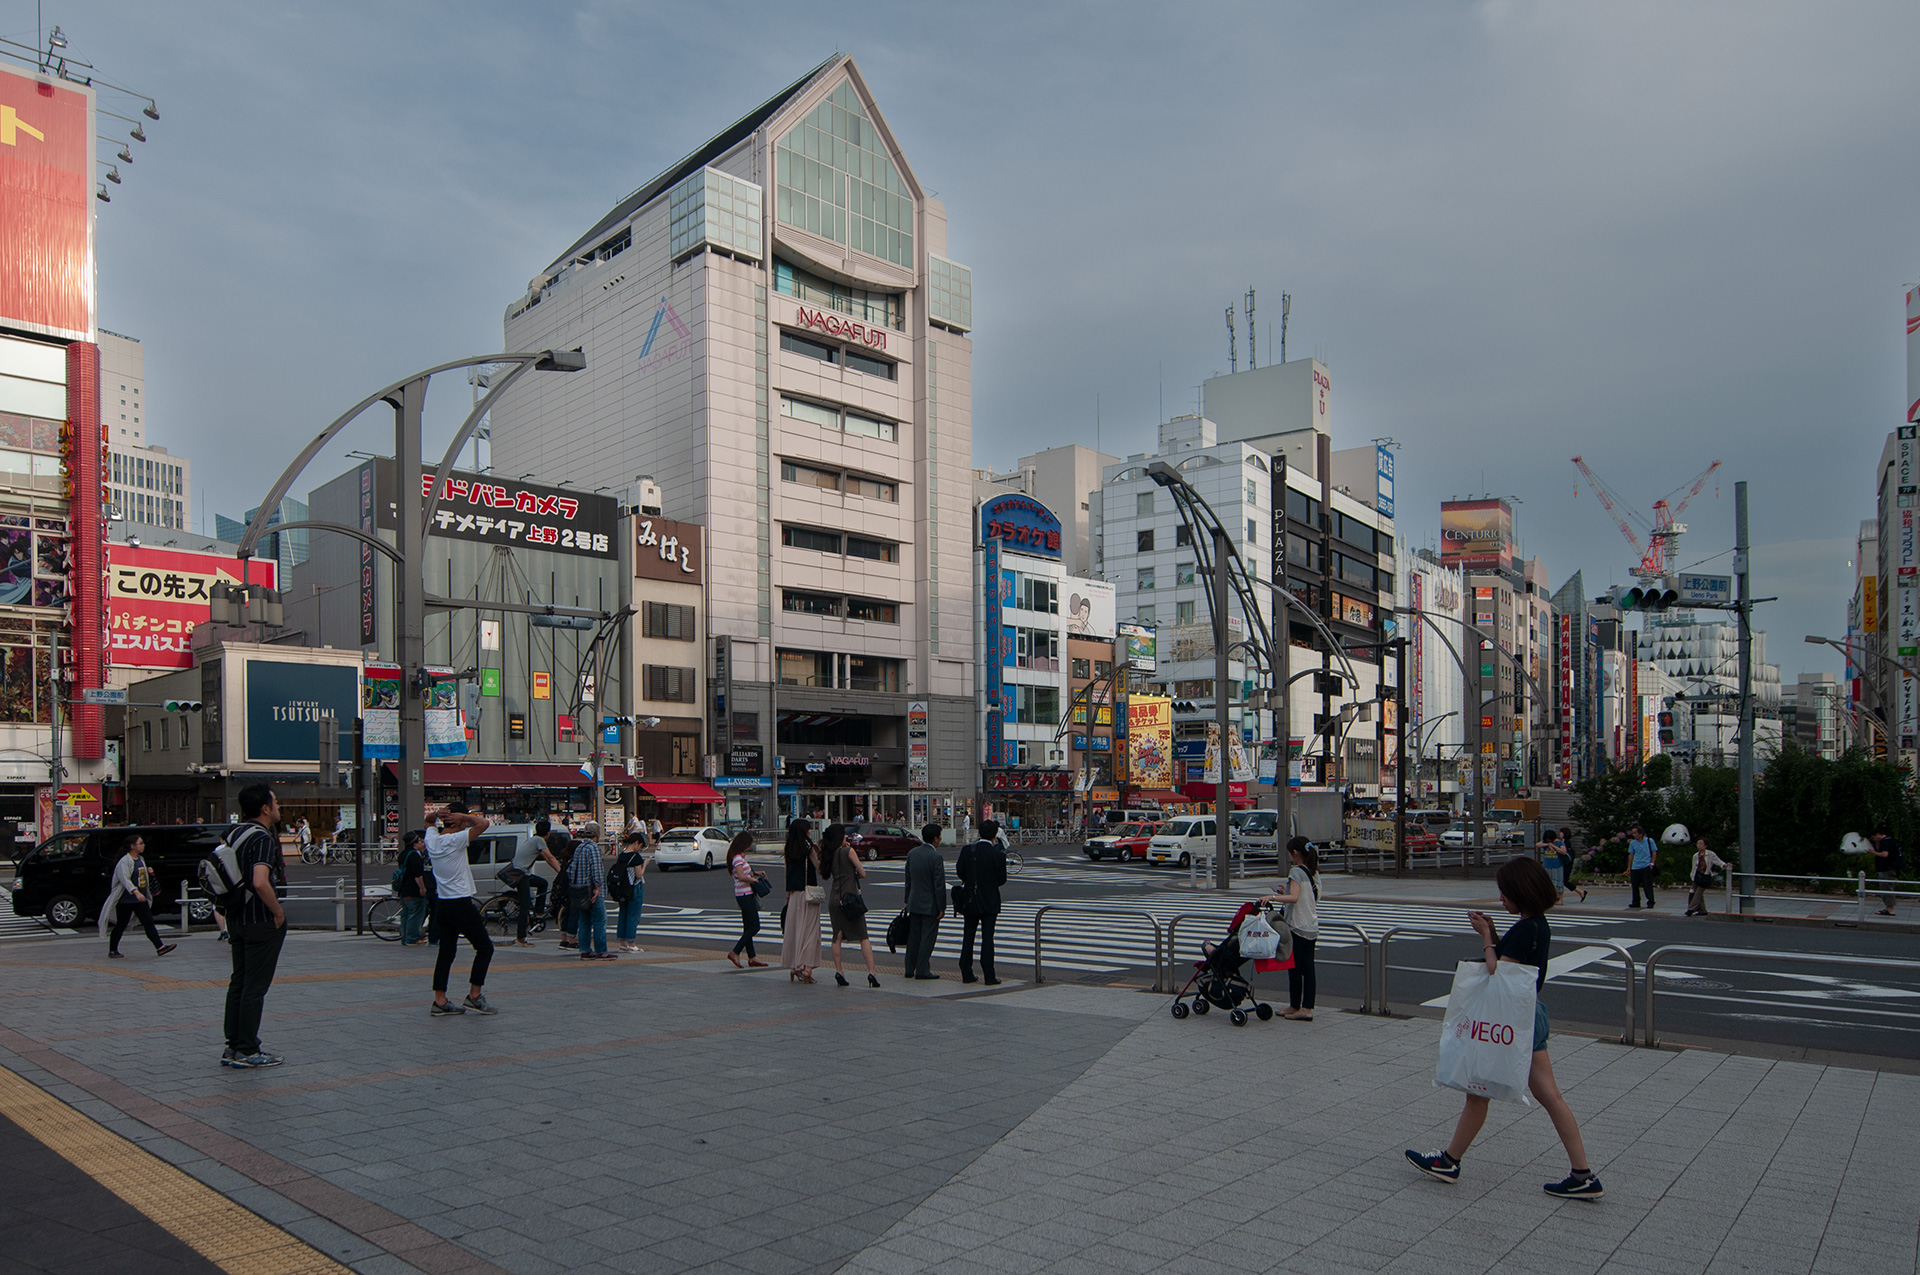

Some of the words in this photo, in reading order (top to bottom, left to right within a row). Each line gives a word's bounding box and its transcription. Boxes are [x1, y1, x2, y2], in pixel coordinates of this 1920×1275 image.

[800, 306, 886, 350] NAGAFUJI
[1313, 369, 1331, 391] PLAZA
[1273, 460, 1284, 474] U
[1901, 442, 1910, 484] SPACE
[988, 518, 1060, 550] カラオケ館
[1274, 508, 1284, 576] PLAZA
[637, 520, 696, 573] みはし
[1683, 578, 1727, 592] 上野公園前
[111, 634, 193, 653] エスパス上
[89, 690, 124, 699] 上野公園前
[272, 706, 335, 722] TSUTSUMI
[990, 714, 998, 764] カラオケ館
[1076, 736, 1108, 745] スポツ用品
[830, 756, 869, 766] NAGAFUJI
[994, 773, 1070, 790] カラオケ館
